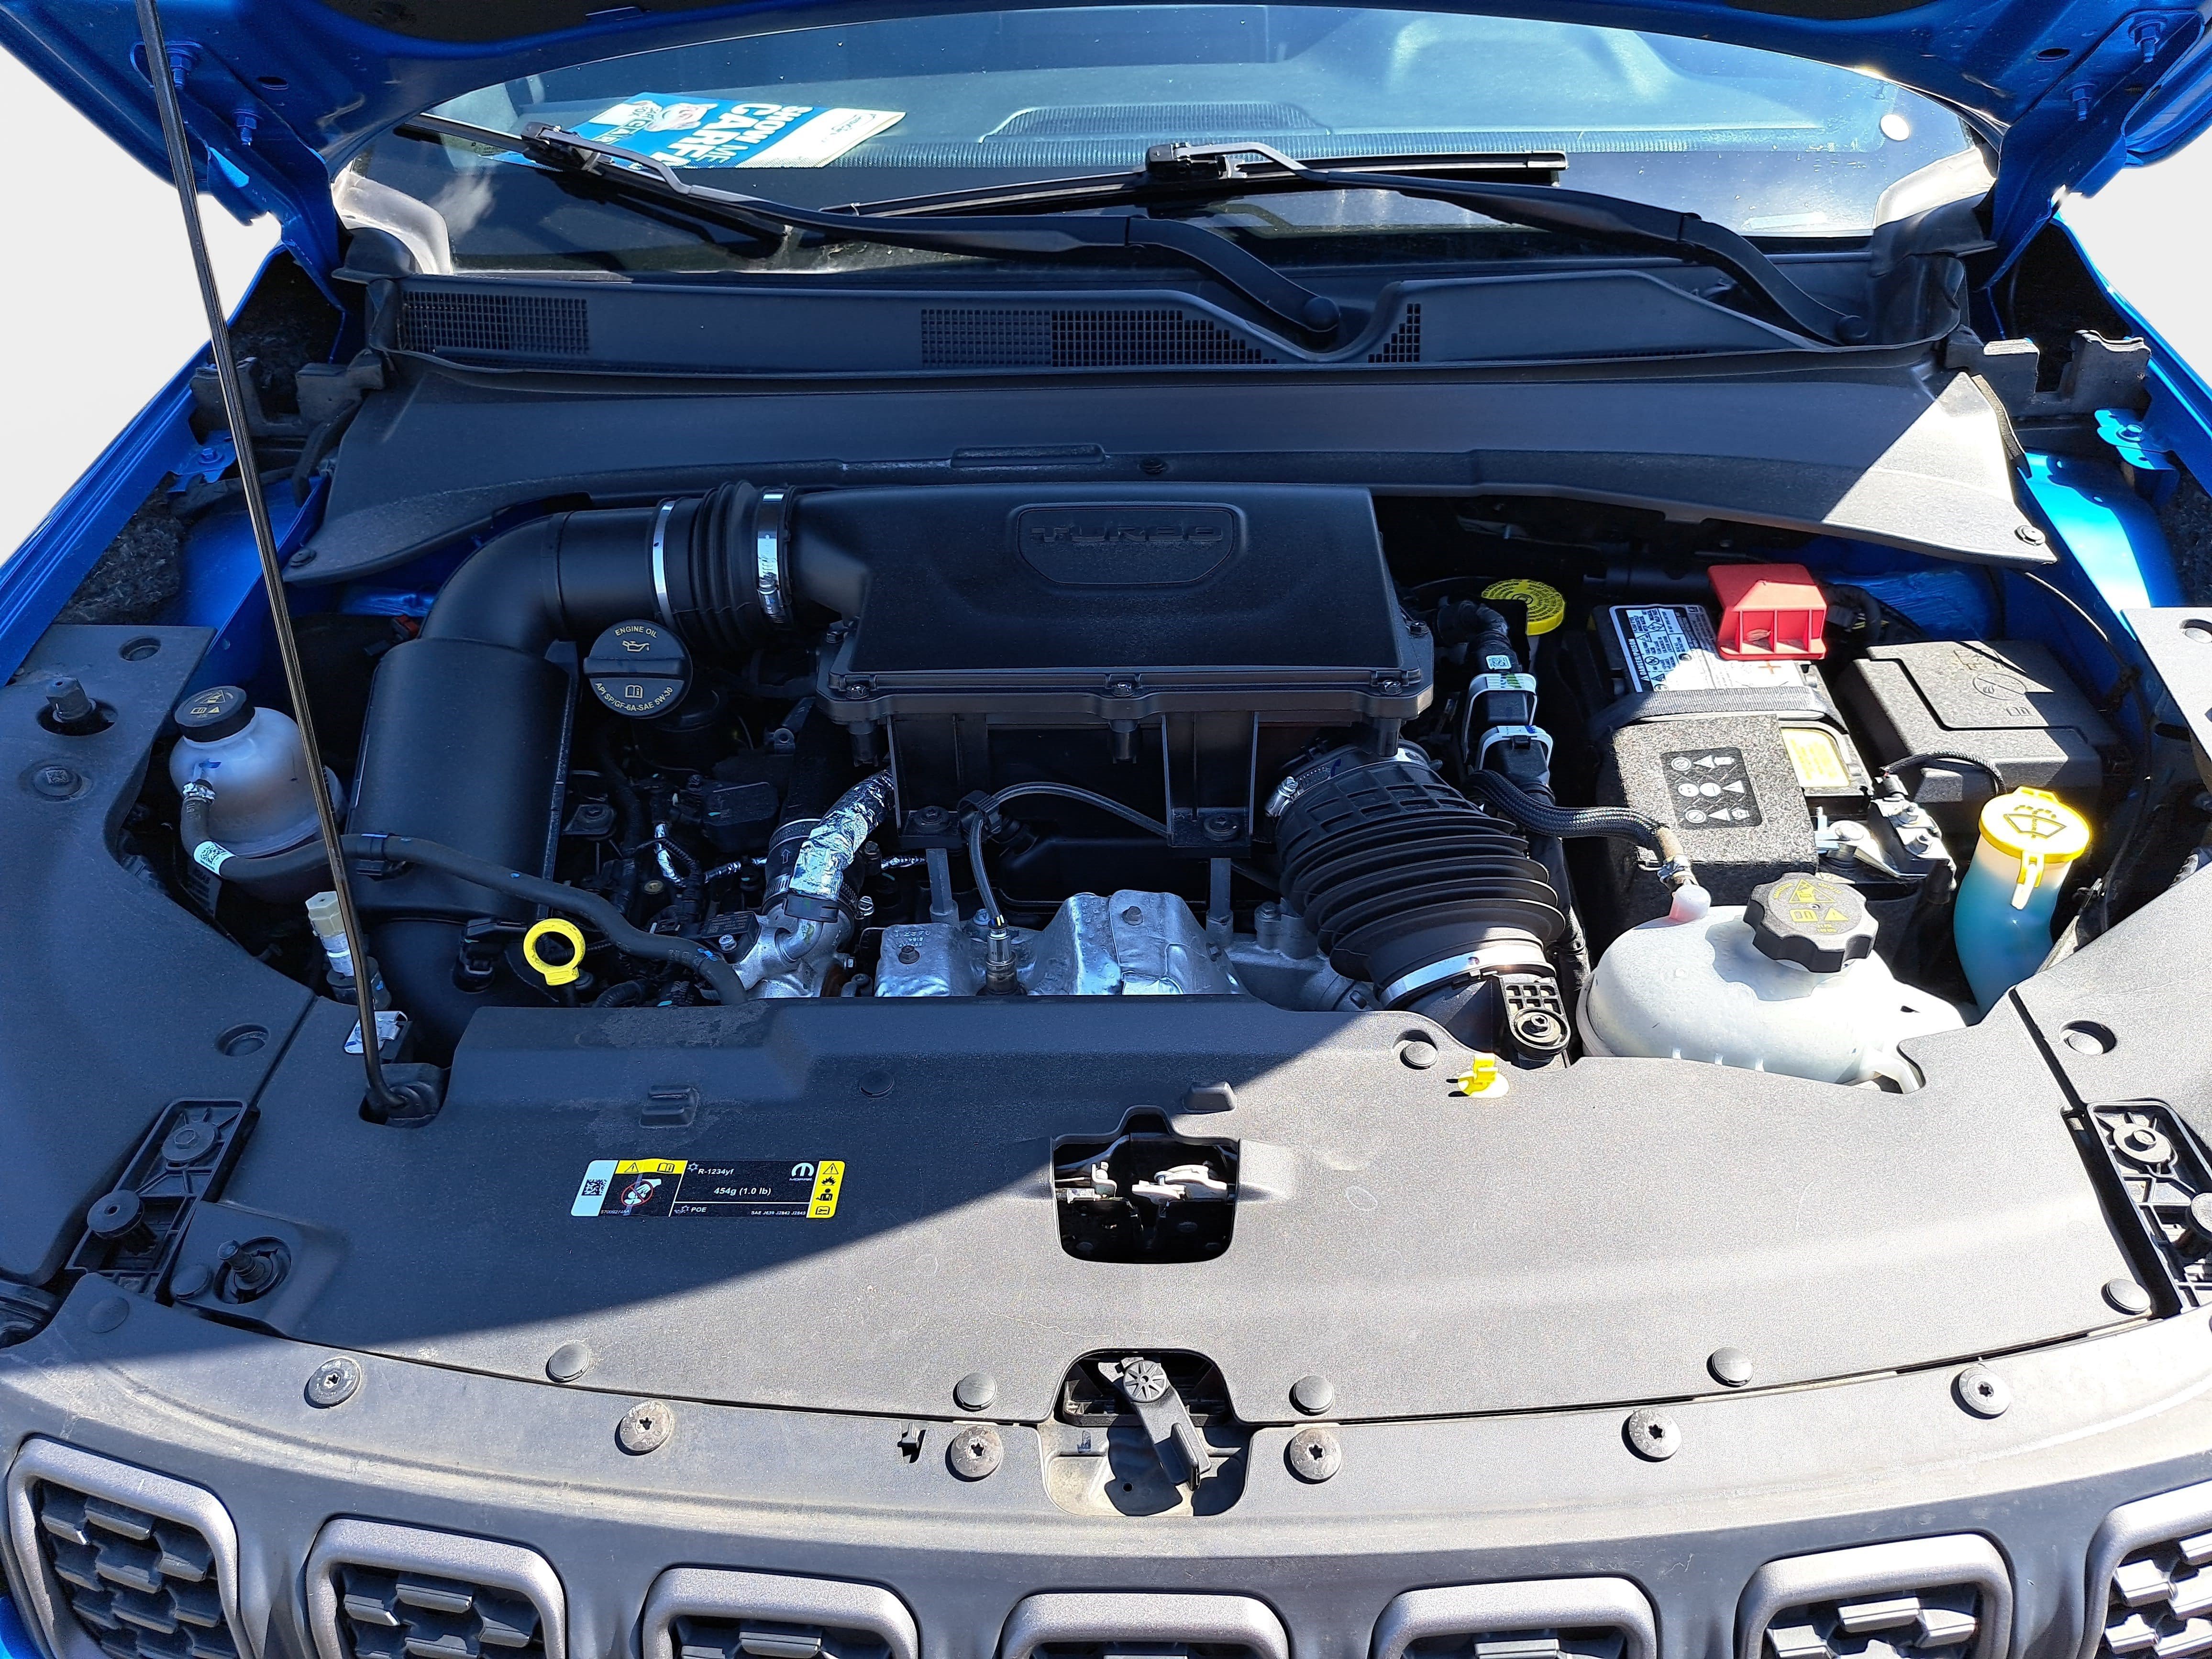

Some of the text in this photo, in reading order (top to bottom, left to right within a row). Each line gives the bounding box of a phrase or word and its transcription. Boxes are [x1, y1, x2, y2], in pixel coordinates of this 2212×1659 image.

[734, 105, 813, 144] SHOW
[651, 103, 783, 167] CARFA
[696, 144, 749, 164] ME
[1030, 526, 1223, 542] TURBO
[615, 626, 658, 639] ENGINE OIL
[595, 683, 607, 695] API
[654, 687, 674, 706] 5W-30
[697, 1168, 733, 1176] R-1234yf
[714, 1187, 771, 1196] 454g (1.0 lb)
